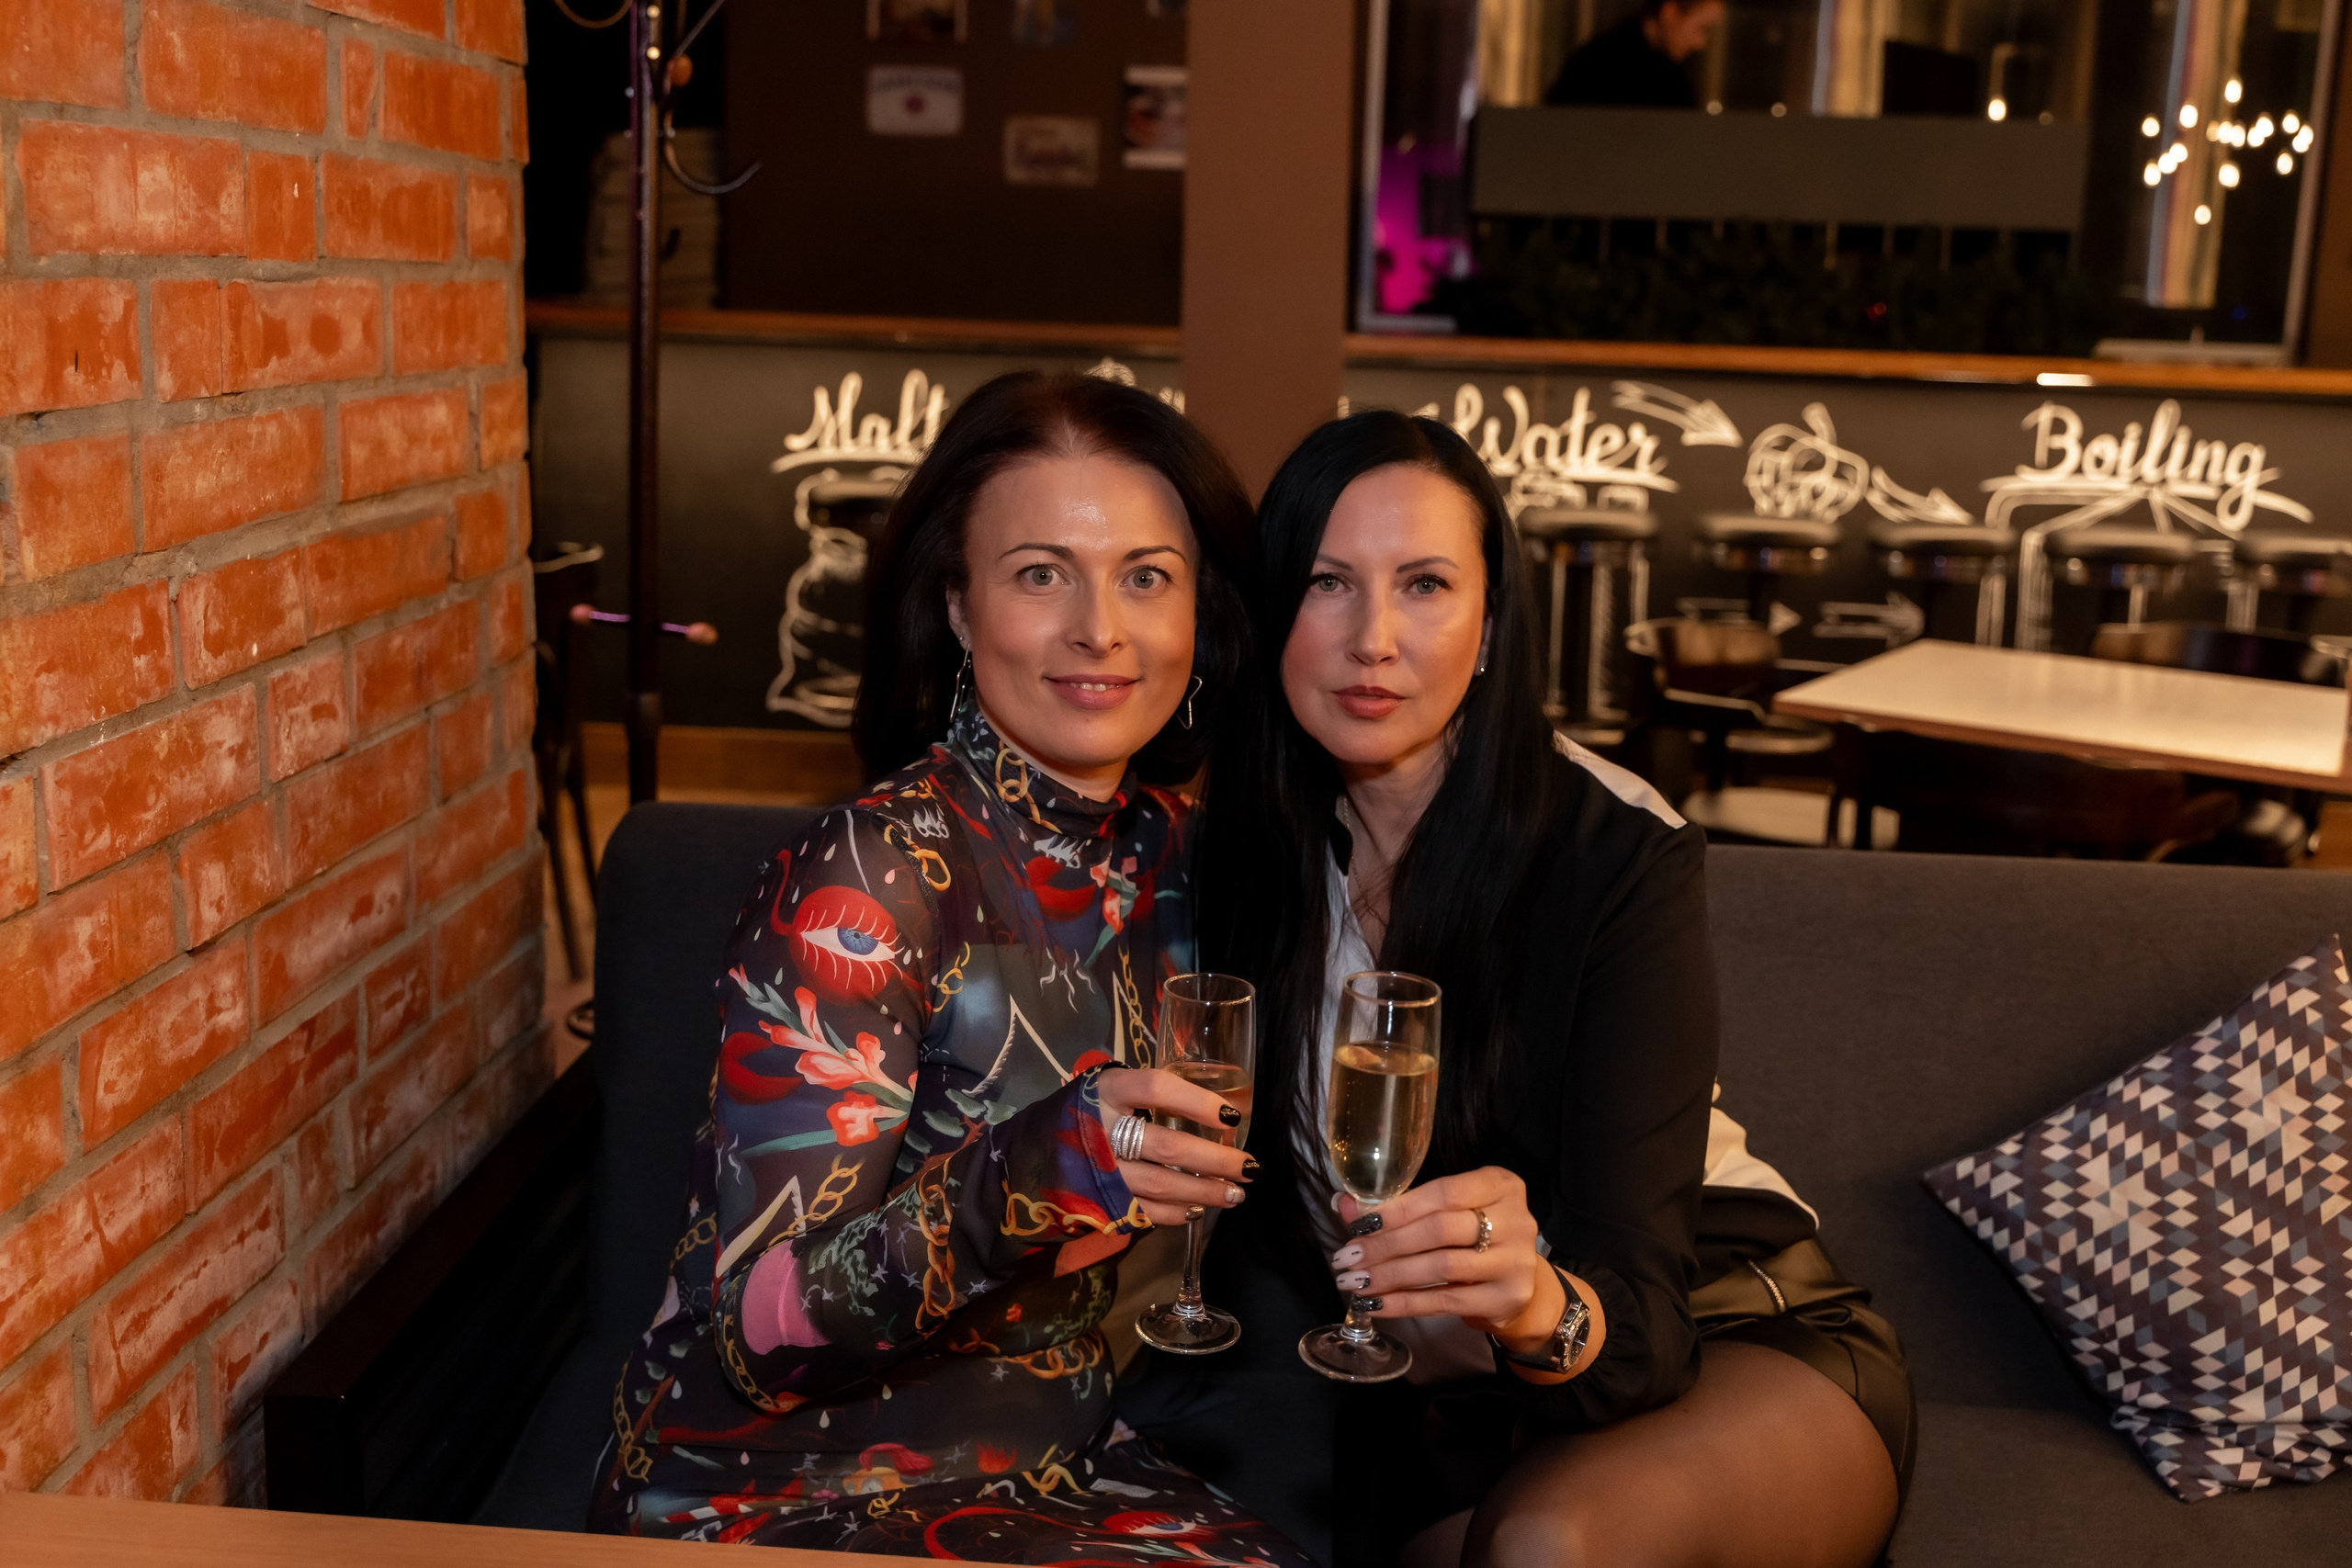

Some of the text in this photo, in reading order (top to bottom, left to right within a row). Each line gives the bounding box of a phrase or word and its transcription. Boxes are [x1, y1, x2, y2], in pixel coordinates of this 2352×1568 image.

[784, 368, 950, 454] Malt
[1453, 382, 1668, 476] Water
[2016, 399, 2288, 531] Boiling
